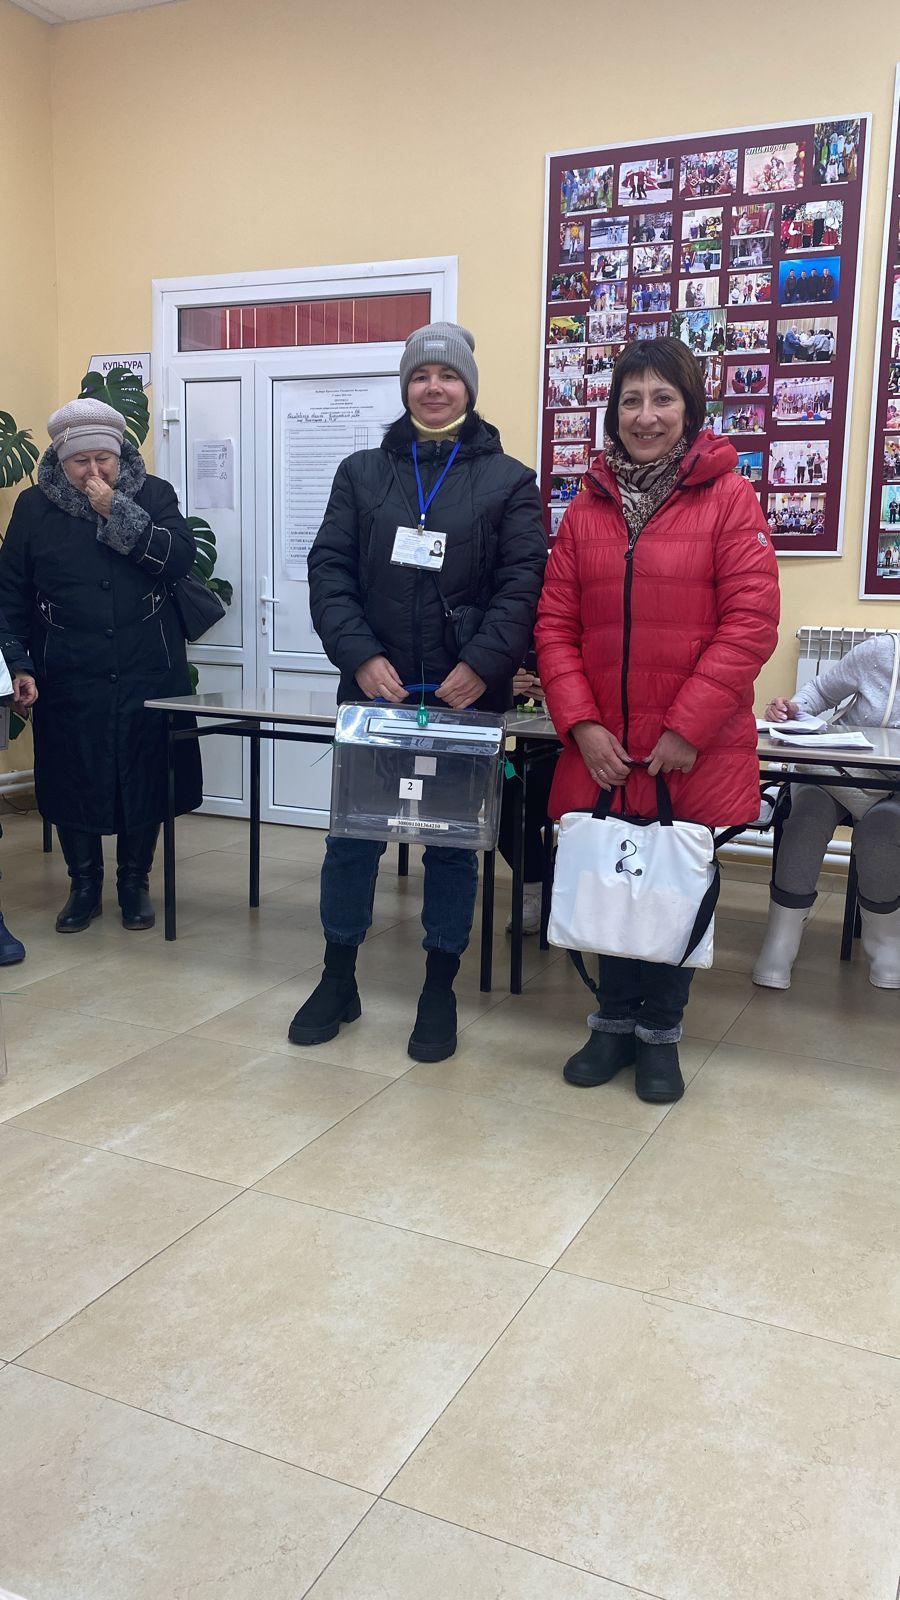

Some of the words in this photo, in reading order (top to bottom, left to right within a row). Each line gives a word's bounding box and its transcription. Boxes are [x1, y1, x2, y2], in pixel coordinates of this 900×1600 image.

[102, 360, 143, 371] КУЛЬТУРА
[407, 781, 413, 791] 2
[615, 839, 643, 876] 2
